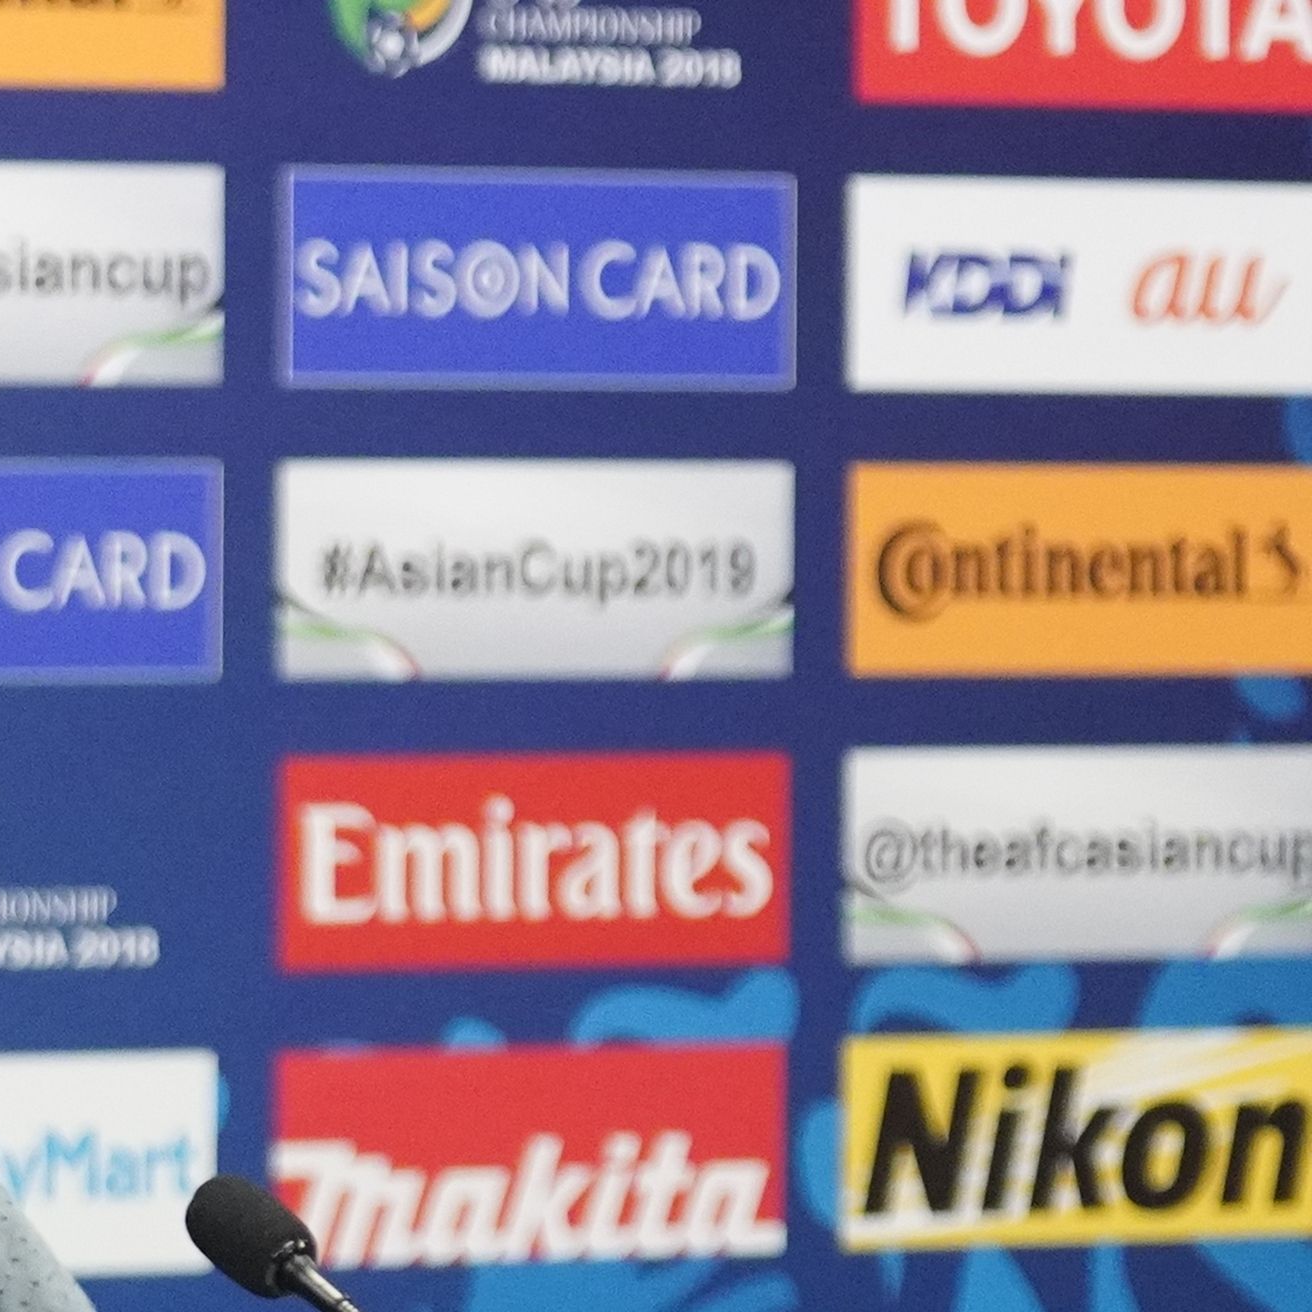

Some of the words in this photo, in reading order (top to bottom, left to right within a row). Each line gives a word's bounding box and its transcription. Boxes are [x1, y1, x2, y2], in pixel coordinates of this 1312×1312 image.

[478, 46, 656, 86] MALAYSIA
[295, 237, 570, 318] SAISON
[579, 238, 780, 321] CARD
[904, 248, 1075, 320] KDDI
[1131, 248, 1288, 325] au
[320, 538, 757, 605] #AsianCup2019
[878, 518, 1248, 625] Continental
[301, 795, 773, 925] Emirates
[864, 1064, 1308, 1214] Nikon
